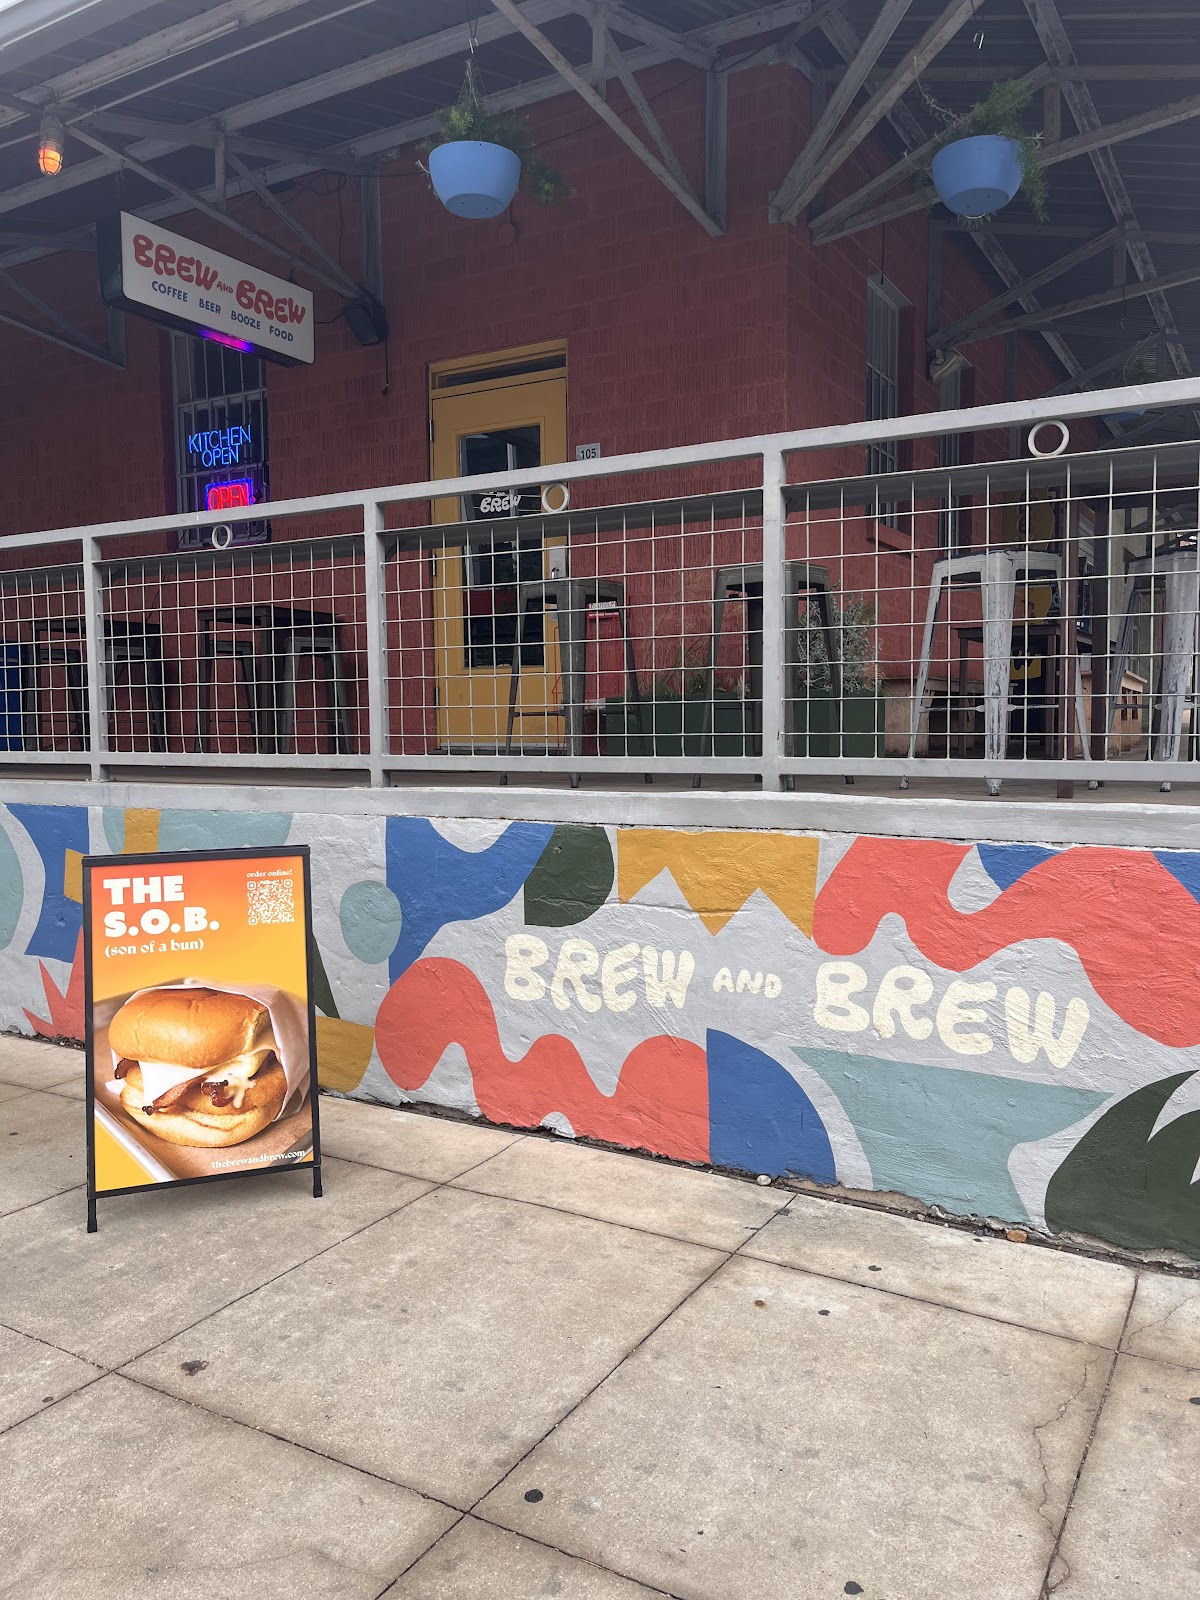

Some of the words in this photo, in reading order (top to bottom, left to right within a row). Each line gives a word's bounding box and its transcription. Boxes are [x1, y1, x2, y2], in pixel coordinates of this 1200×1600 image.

[133, 233, 219, 290] BREW
[216, 280, 234, 294] AND
[236, 279, 306, 325] BREW
[151, 280, 188, 302] COFFEE
[198, 297, 221, 314] BEER
[230, 310, 261, 330] BOOZE
[269, 325, 294, 342] FOOD
[188, 424, 252, 453] KITCHEN
[201, 442, 239, 467] OPEN
[580, 448, 597, 460] 105
[207, 482, 250, 511] OPEN
[480, 494, 521, 513] BREW
[246, 870, 267, 878] order
[267, 868, 293, 877] online!
[103, 875, 185, 905] THE
[103, 906, 220, 938] S.O.B.
[104, 943, 137, 959] (son
[140, 940, 156, 954] of
[158, 943, 167, 953] a
[170, 938, 205, 952] bun)
[503, 932, 696, 1013] BREW
[712, 966, 783, 998] AND
[813, 960, 1090, 1069] BREW
[211, 1149, 306, 1169] thebrewandbrew.com
